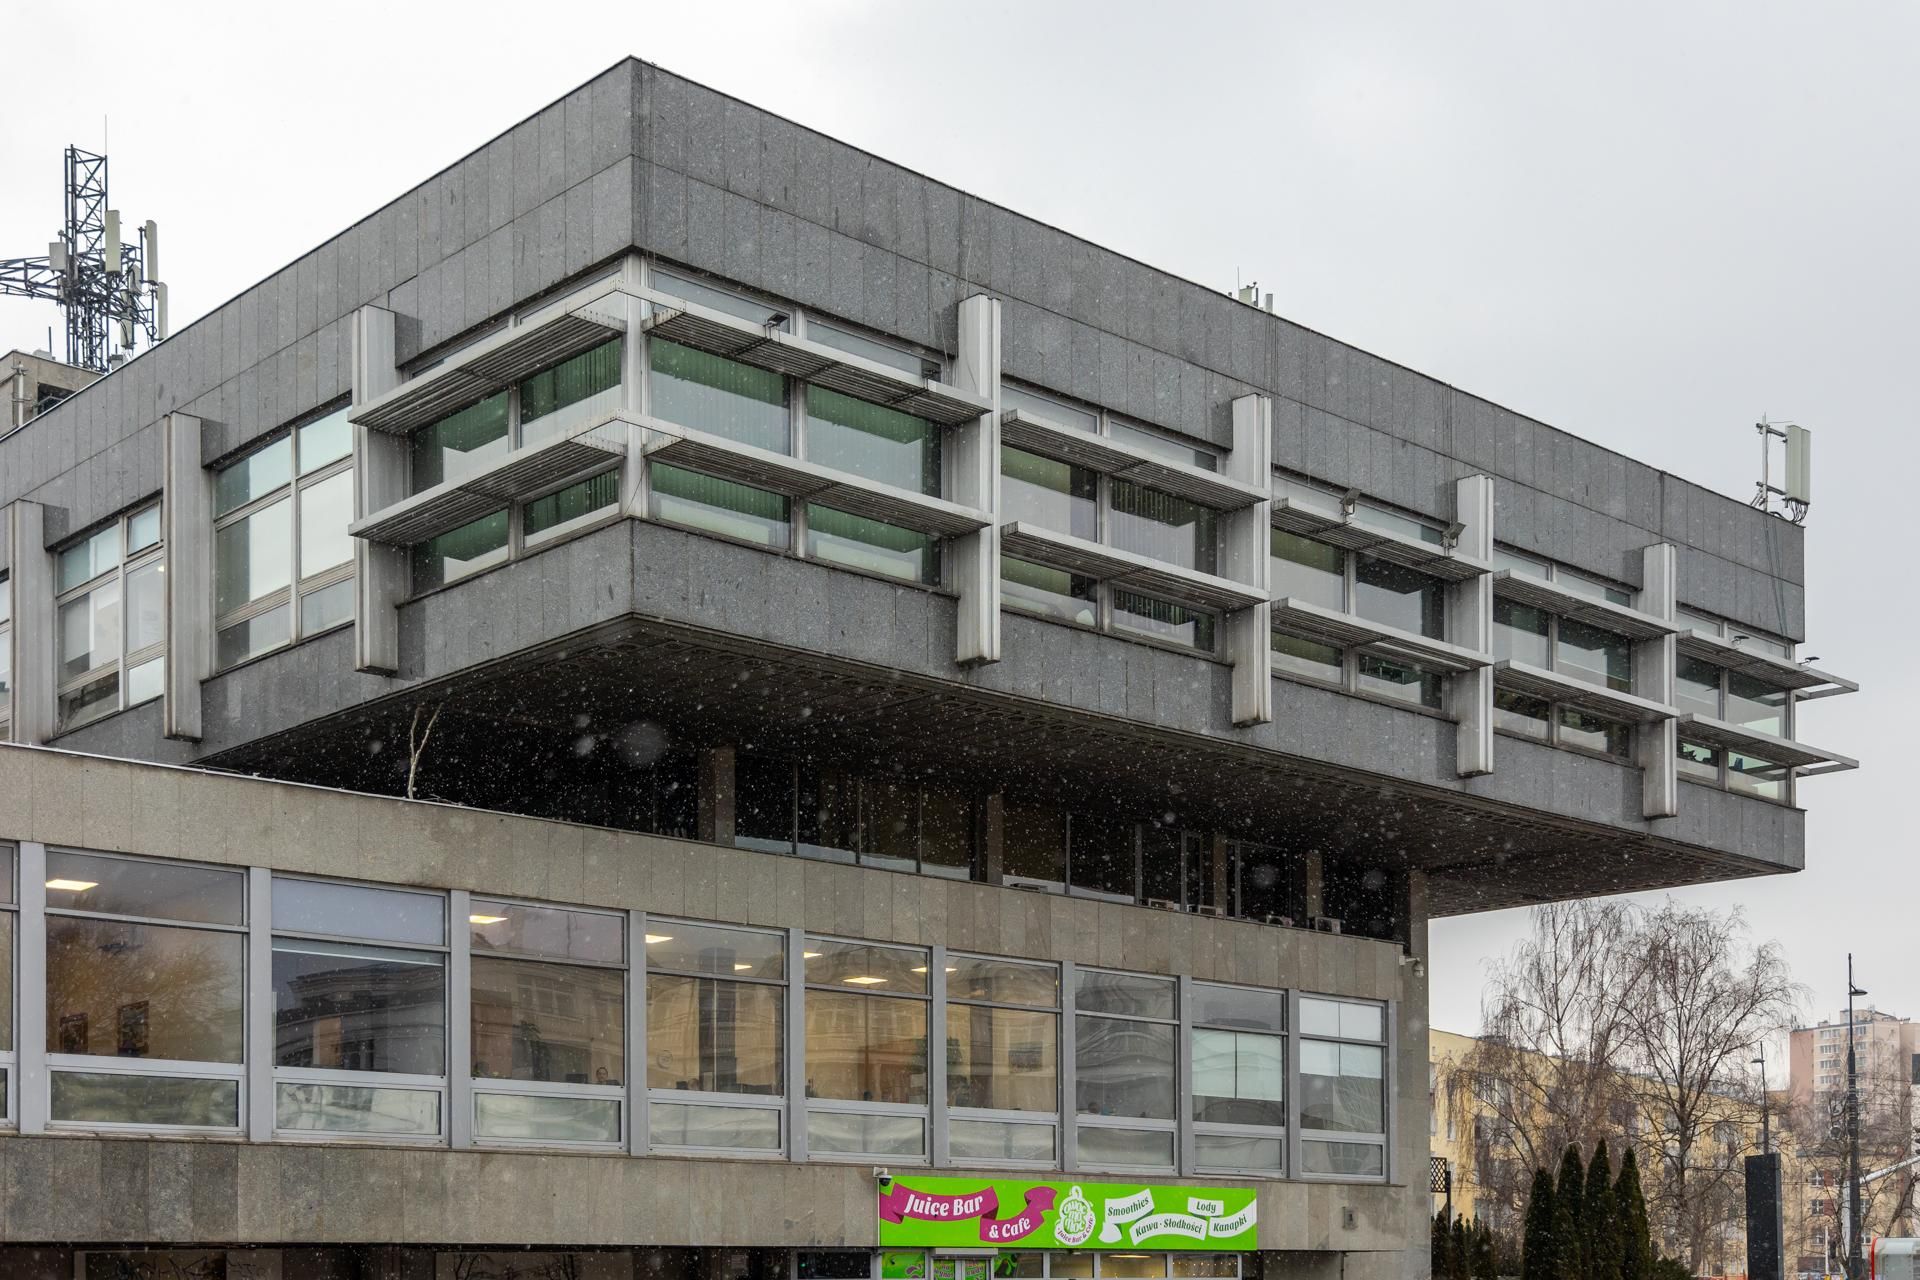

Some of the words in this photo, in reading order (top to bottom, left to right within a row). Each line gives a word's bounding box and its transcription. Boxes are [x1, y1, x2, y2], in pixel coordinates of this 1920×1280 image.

[904, 1194, 949, 1217] Juice
[953, 1196, 984, 1216] Bar
[1107, 1196, 1149, 1216] Smoothies
[1196, 1201, 1217, 1214] Lody
[989, 1224, 999, 1239] &
[1001, 1217, 1031, 1238] Cafe
[1135, 1221, 1159, 1237] Kawa
[1163, 1218, 1203, 1234] Słodkości
[1213, 1213, 1248, 1232] Kanapki
